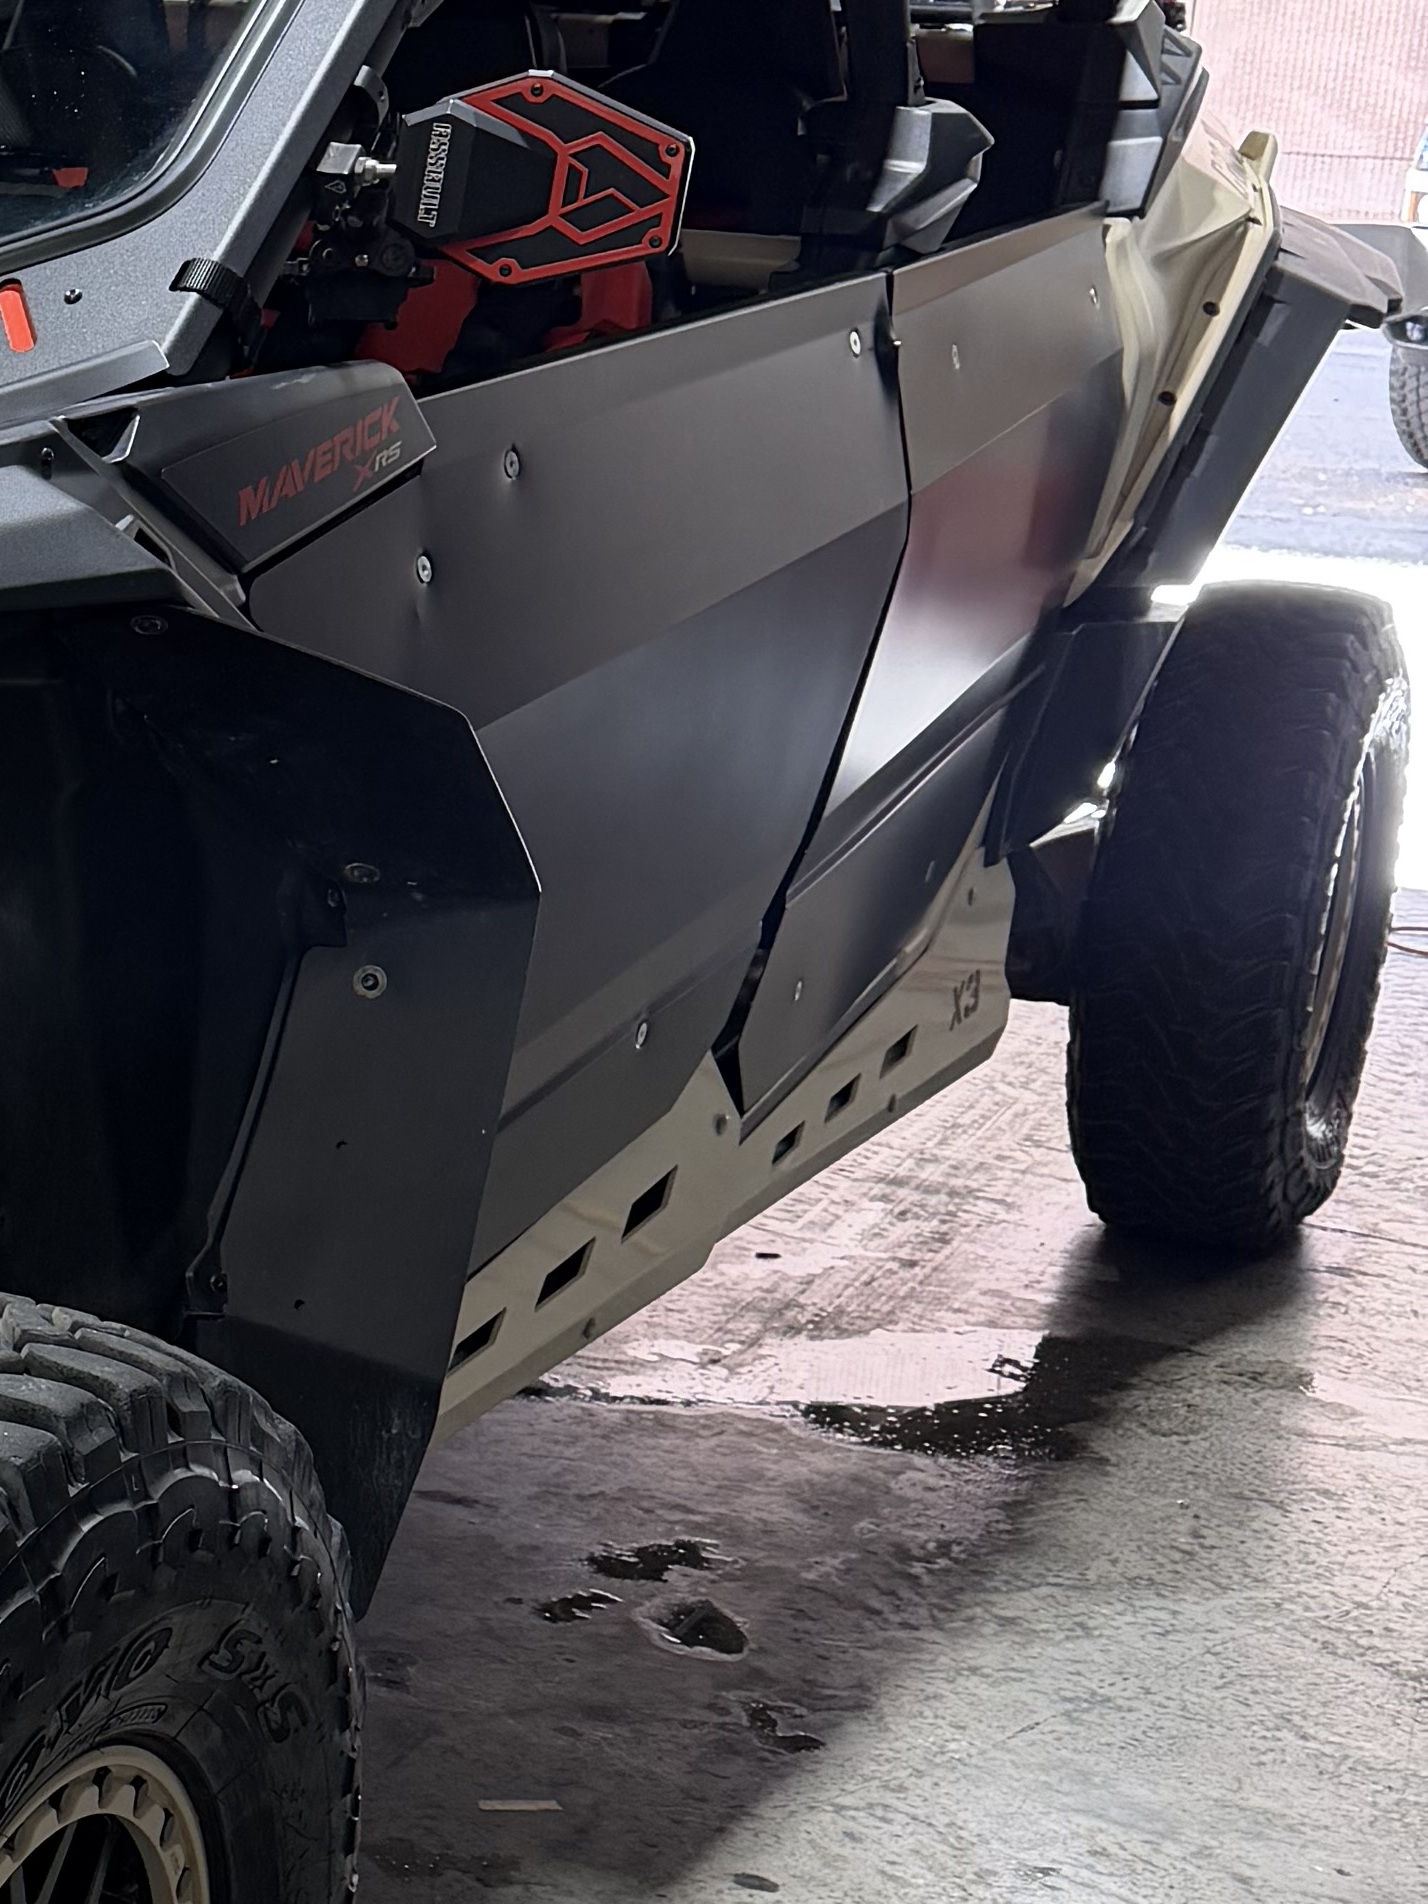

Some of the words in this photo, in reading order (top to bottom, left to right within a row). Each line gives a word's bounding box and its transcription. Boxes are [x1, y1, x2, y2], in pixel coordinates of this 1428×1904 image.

[416, 122, 453, 228] ASSAULT
[237, 396, 401, 528] MAVERICK
[948, 968, 981, 1032] X3
